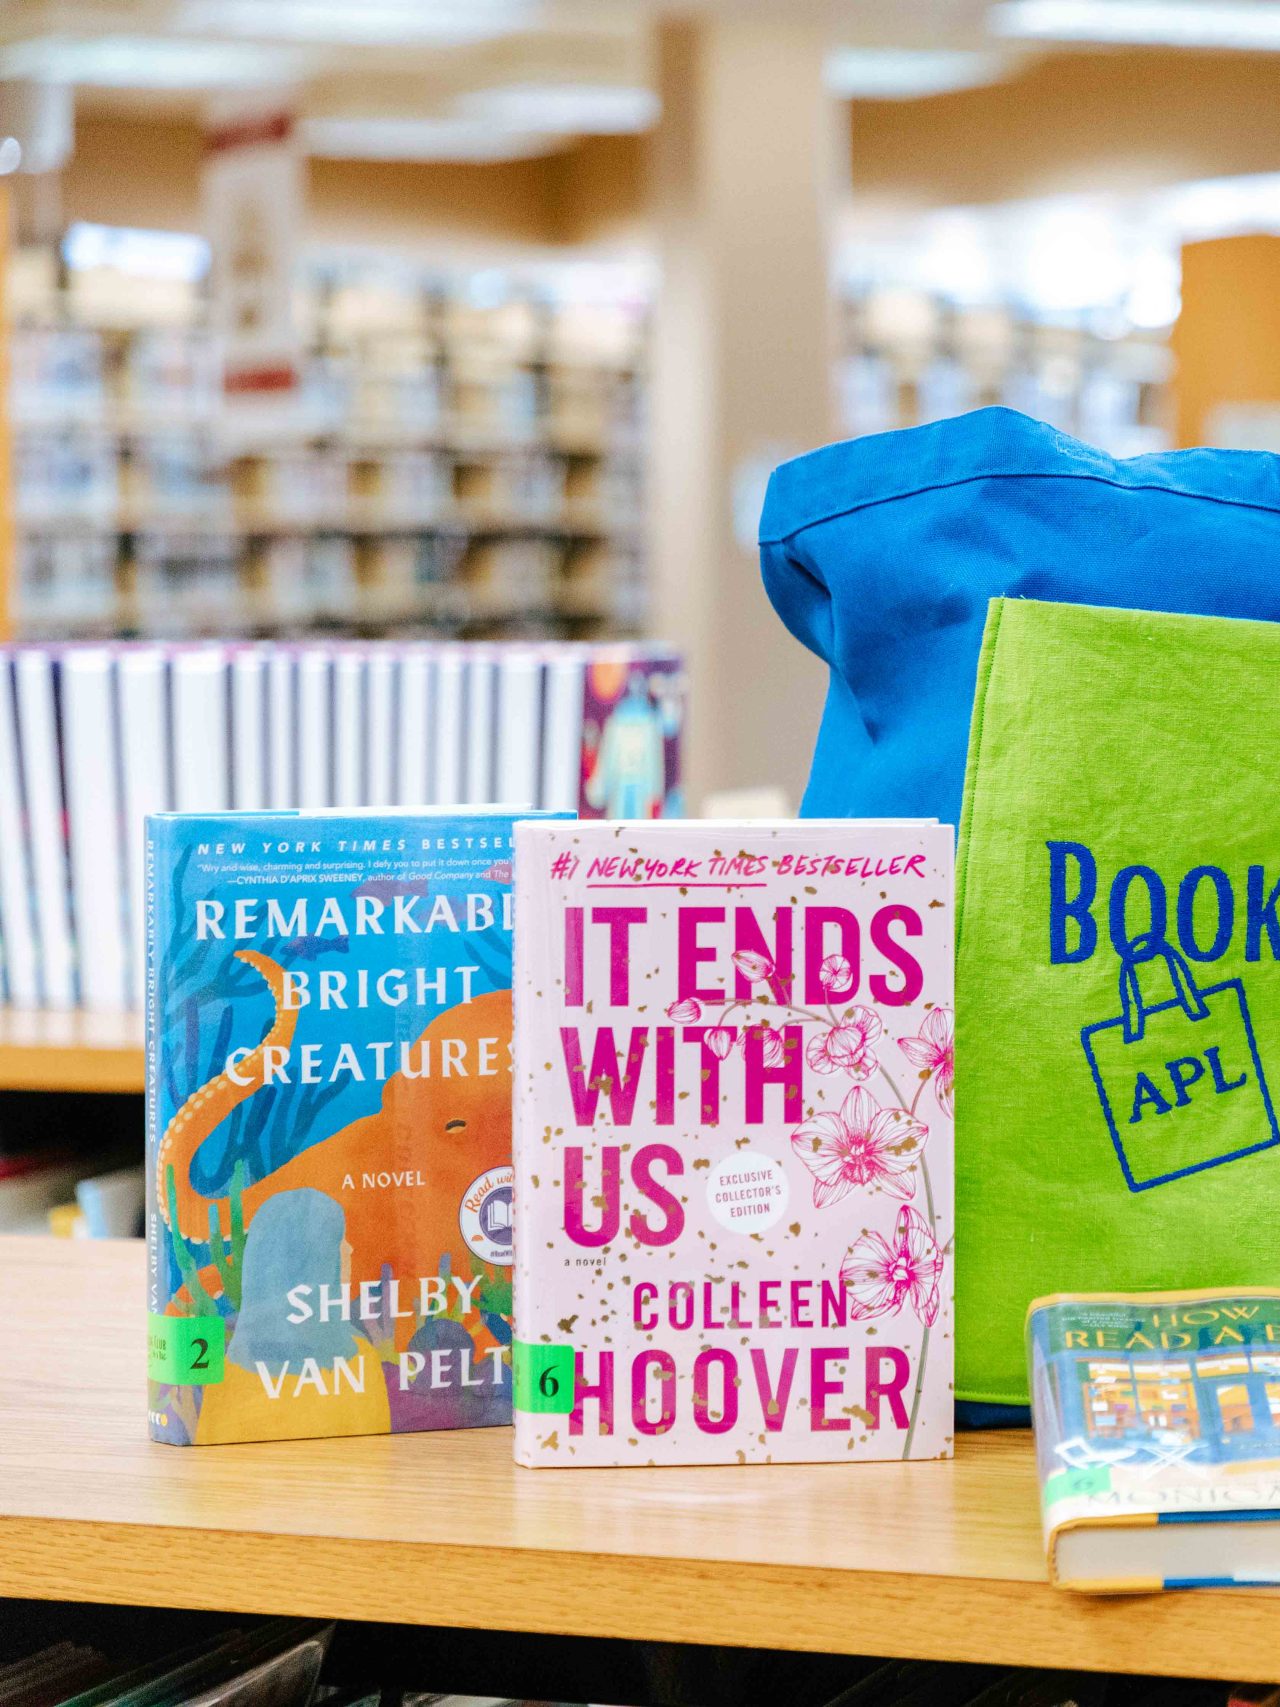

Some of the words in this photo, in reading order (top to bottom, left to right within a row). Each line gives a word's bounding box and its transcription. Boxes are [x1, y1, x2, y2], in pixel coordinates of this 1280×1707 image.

[197, 843, 245, 855] NEW
[262, 842, 321, 853] YORK
[338, 839, 405, 851] TIMES
[221, 863, 236, 872] and
[238, 862, 260, 872] wise,
[263, 862, 302, 873] charming
[305, 861, 320, 870] and
[373, 859, 392, 869] defy
[393, 860, 409, 869] you
[411, 859, 420, 867] to
[422, 859, 437, 868] put
[438, 858, 444, 866] it
[446, 858, 469, 866] down
[471, 858, 492, 866] once
[368, 873, 394, 882] author
[396, 873, 405, 881] of
[409, 872, 432, 880] Good
[434, 871, 473, 882] Company
[475, 870, 491, 879] and
[494, 869, 509, 878] The
[550, 852, 577, 880] #1
[588, 857, 640, 878] NEW
[645, 858, 701, 878] YORK
[707, 856, 768, 877] TIMES
[777, 855, 927, 878] BESTSELLER
[565, 907, 647, 1007] IT
[678, 904, 923, 1007] ENDS
[282, 966, 479, 1011] BRIGHT
[226, 1037, 513, 1086] CREATURE
[560, 1026, 803, 1126] WITH
[1129, 1046, 1248, 1124] APL
[342, 1174, 355, 1189] A
[363, 1171, 426, 1188] NOVEL
[720, 1170, 773, 1187] EXCLUSIVE
[465, 1177, 493, 1213] Read
[564, 1143, 685, 1248] US
[715, 1186, 782, 1203] COLLECTOR'S
[730, 1203, 770, 1217] EDITION
[576, 1256, 606, 1267] novel
[287, 1275, 483, 1324] SHELBY
[633, 1280, 847, 1332] COLLEEN
[1152, 1306, 1260, 1328] HOW
[1065, 1330, 1192, 1350] READ
[1214, 1324, 1243, 1345] A
[190, 1338, 209, 1369] 2
[256, 1356, 365, 1399] VAN
[399, 1346, 511, 1390] PELT
[539, 1365, 560, 1397] 6
[568, 1346, 910, 1436] HOOVER
